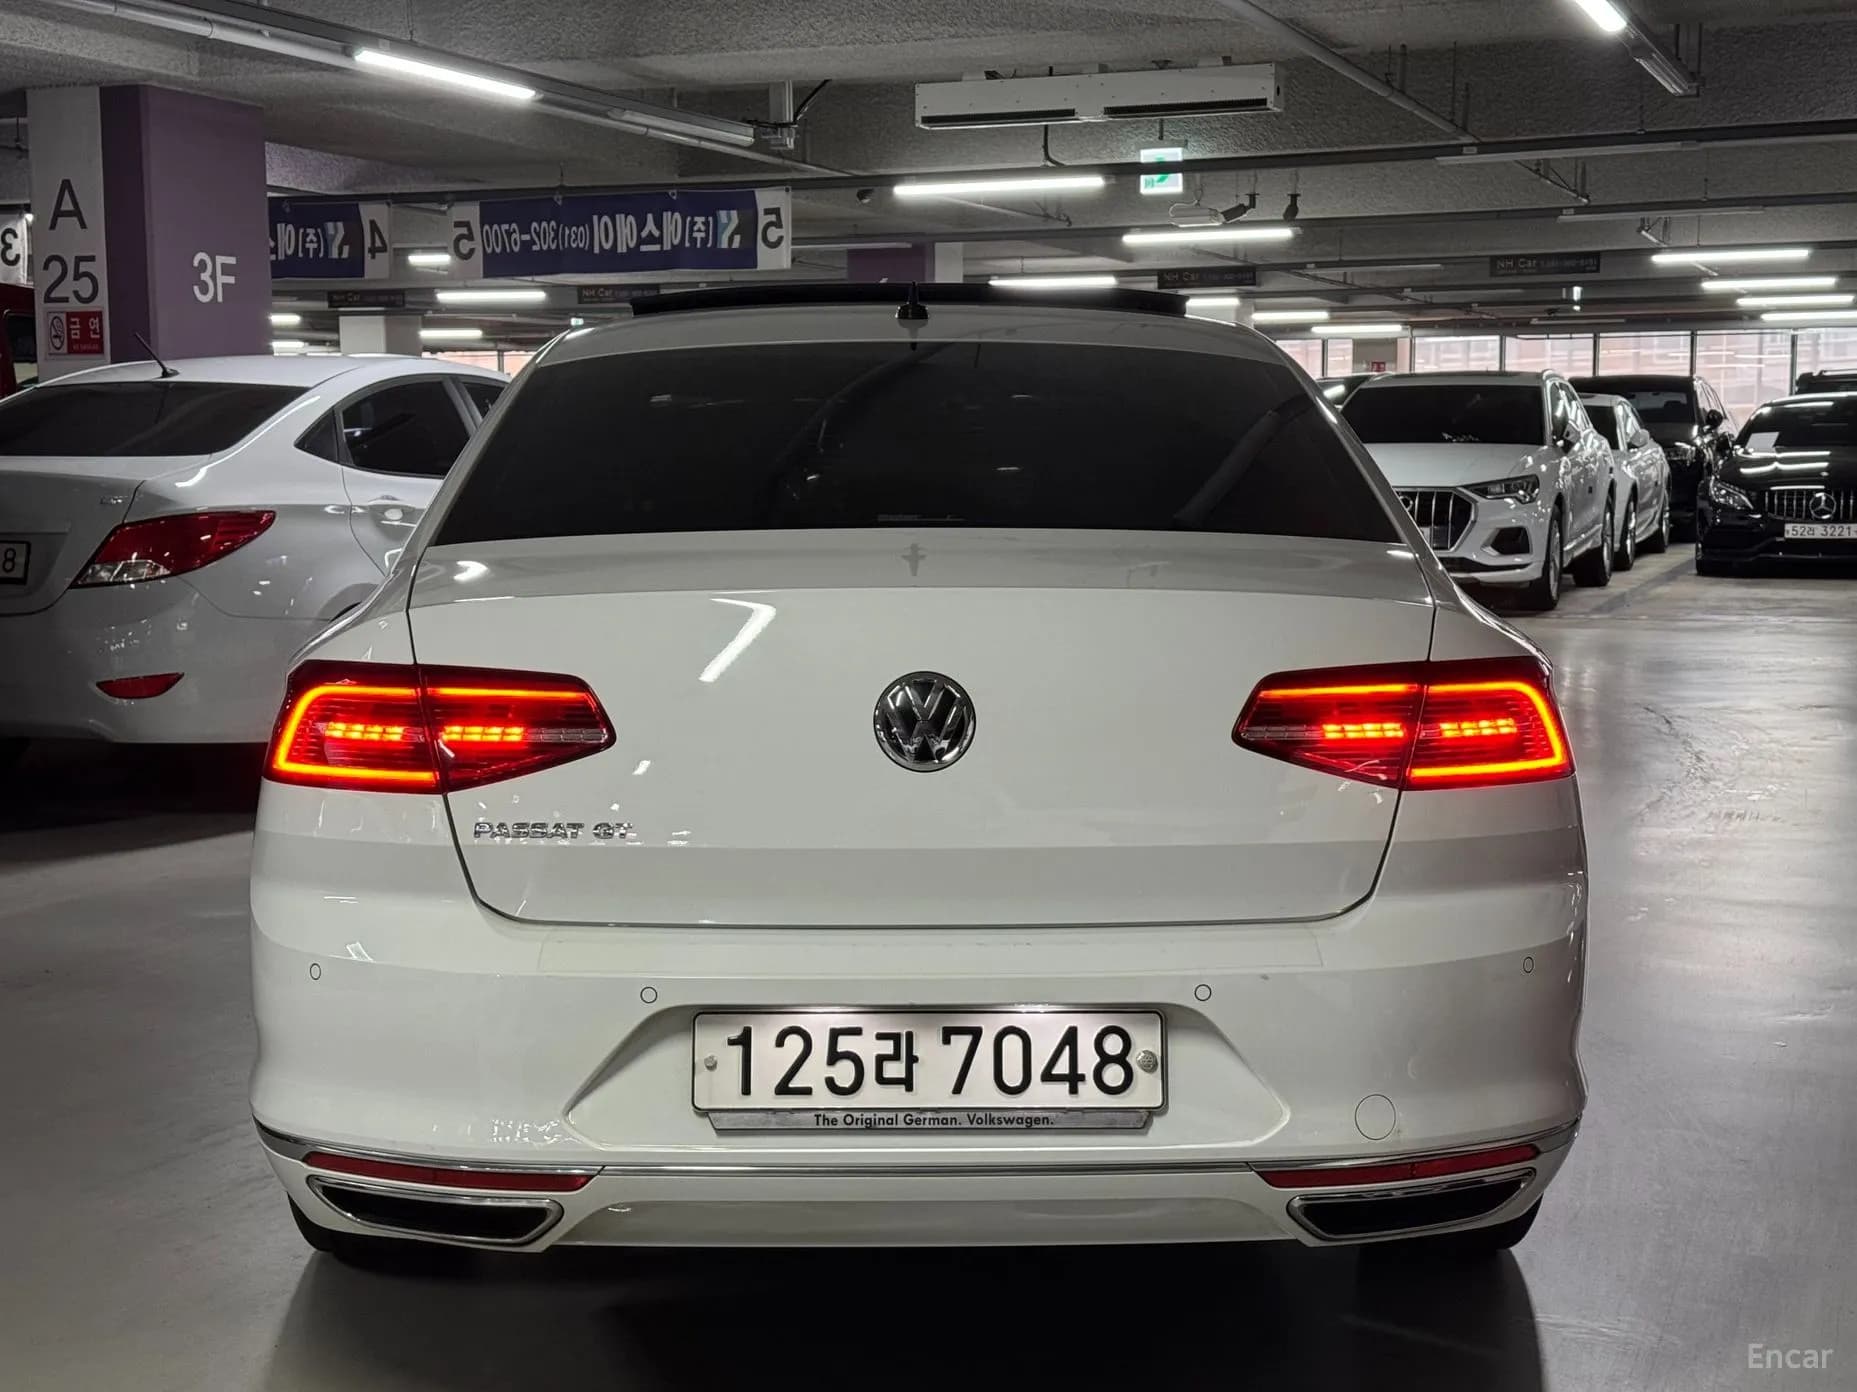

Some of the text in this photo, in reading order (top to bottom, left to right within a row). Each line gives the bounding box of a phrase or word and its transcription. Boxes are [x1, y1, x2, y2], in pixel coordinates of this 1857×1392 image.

[49, 178, 88, 231] A
[42, 254, 99, 305] 25
[192, 251, 237, 303] 3F
[1820, 525, 1852, 537] 3221
[473, 822, 585, 839] PASSAT
[727, 1025, 1135, 1096] 125라 7048
[814, 1112, 1054, 1129] The Original German. Volkswagen.
